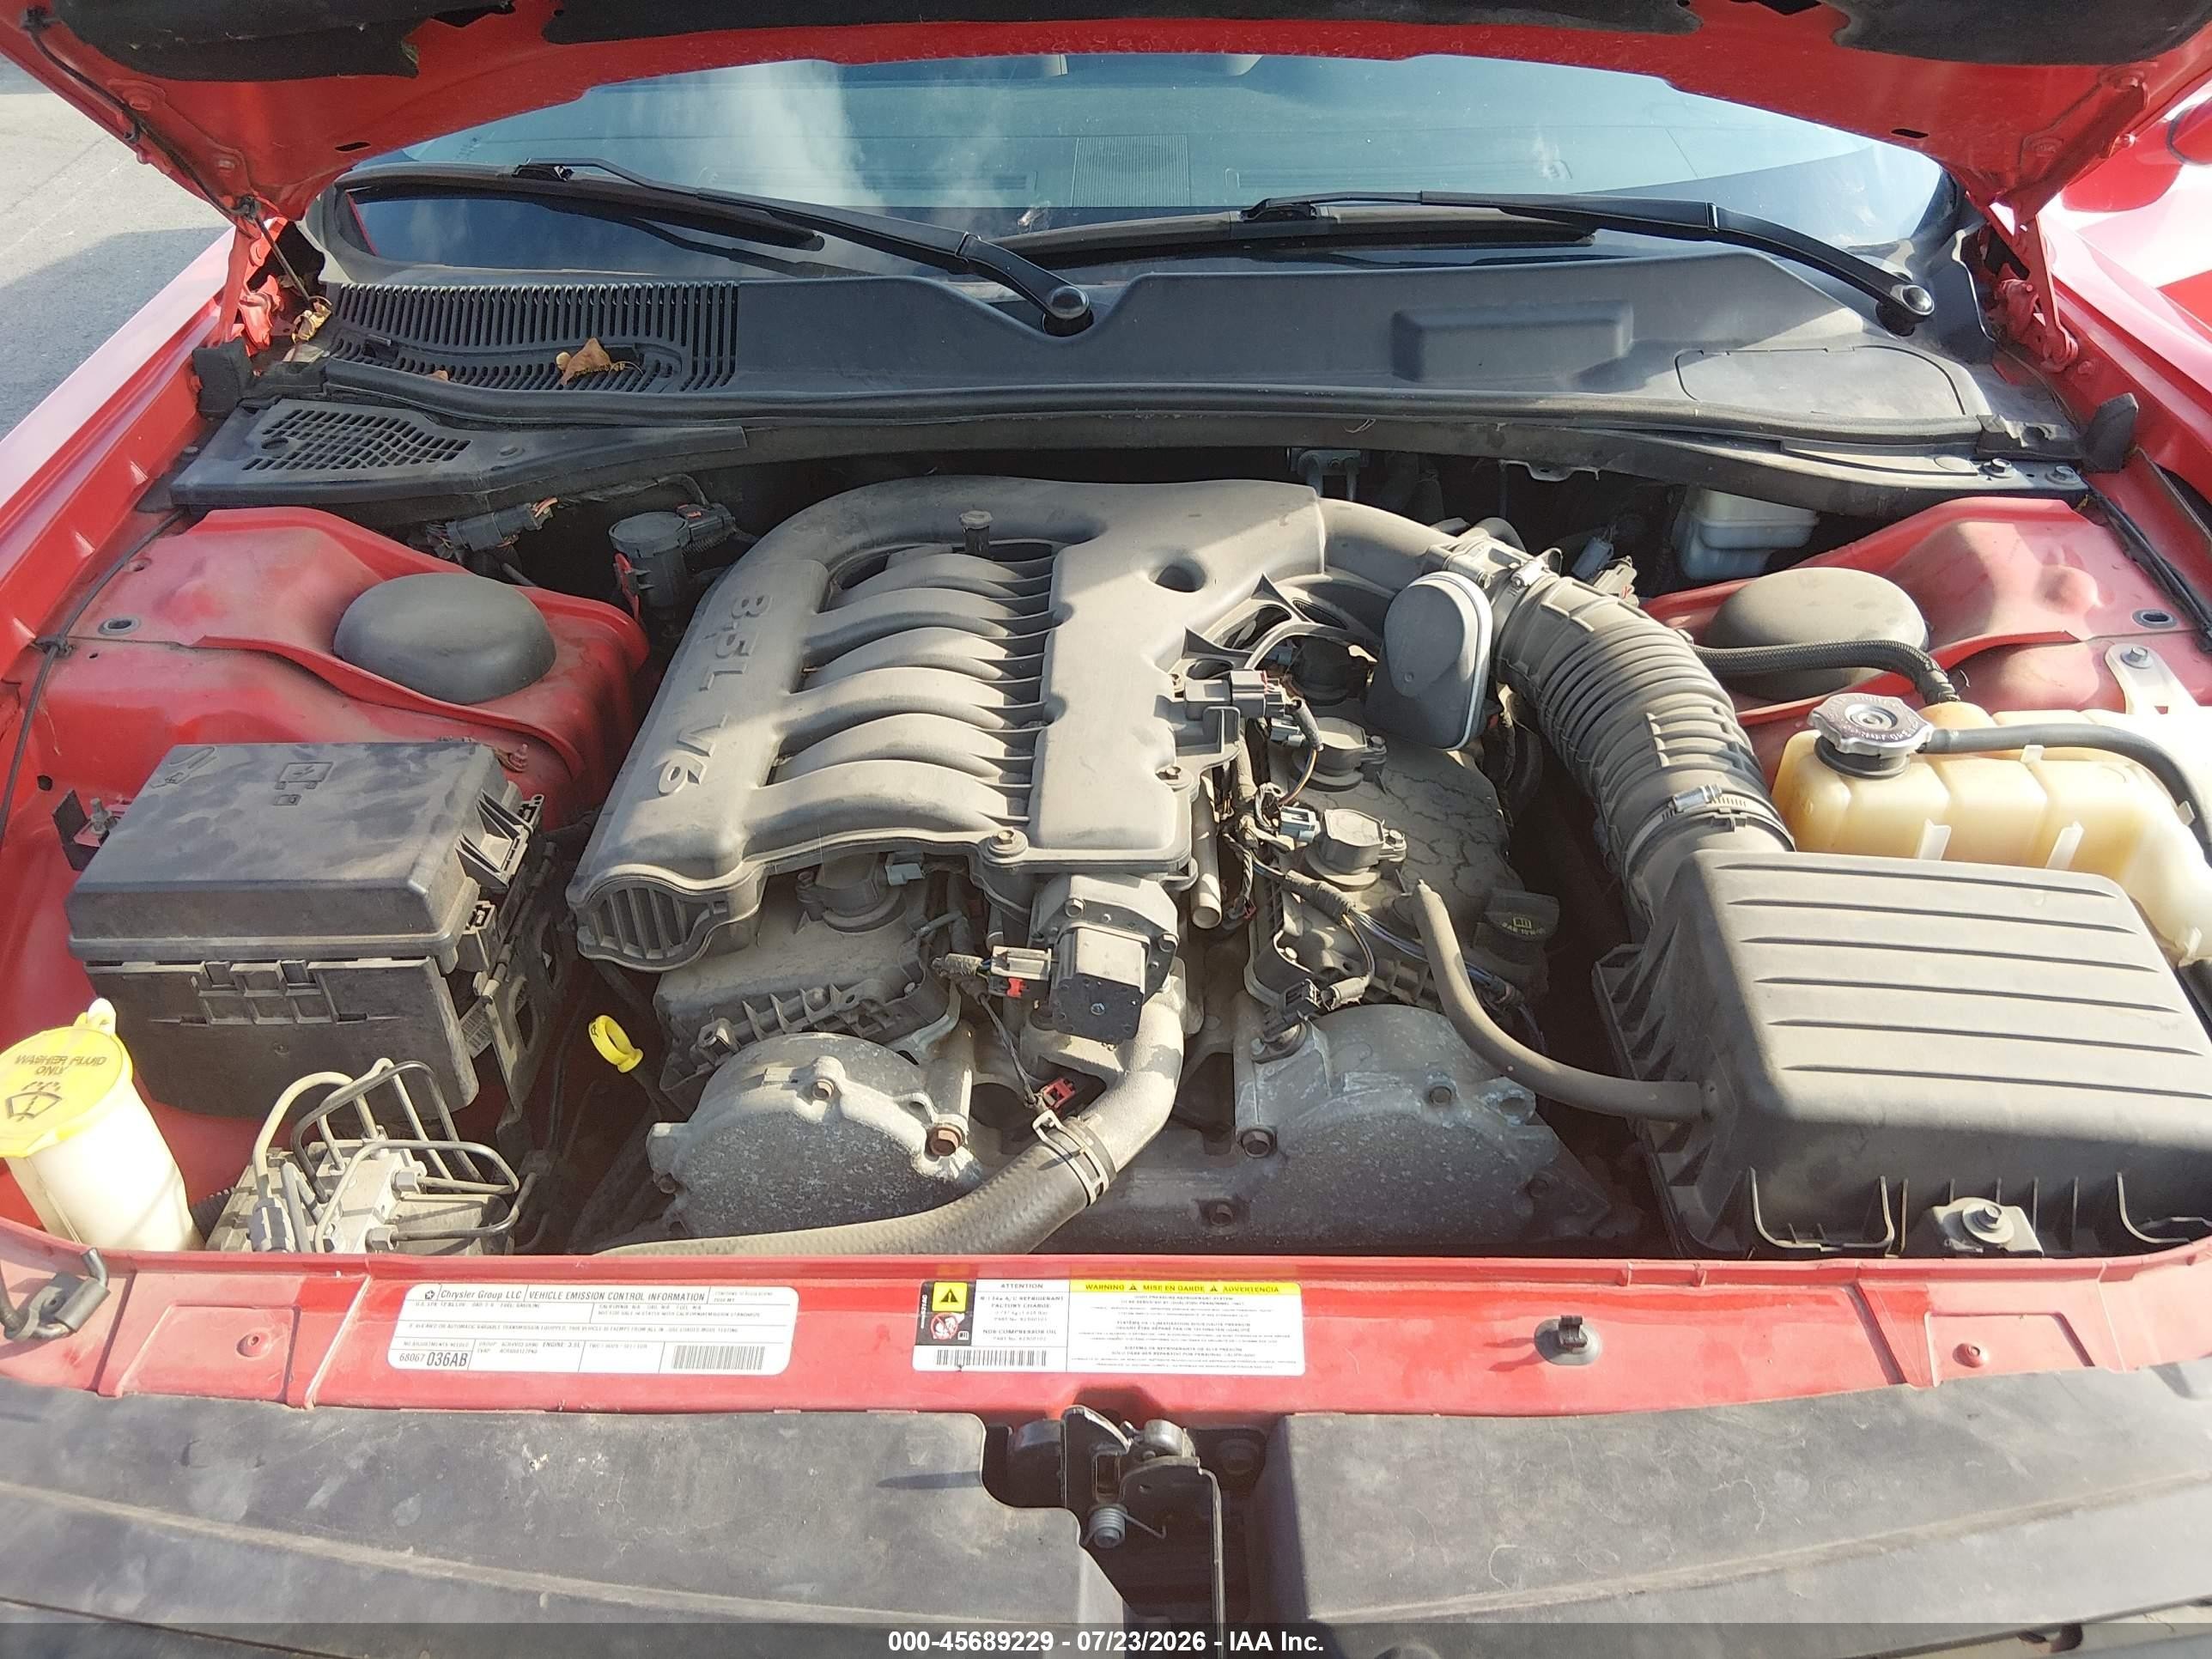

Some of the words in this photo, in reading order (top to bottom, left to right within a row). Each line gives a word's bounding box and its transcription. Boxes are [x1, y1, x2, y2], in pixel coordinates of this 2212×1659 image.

[659, 714, 727, 796] V6
[15, 1054, 67, 1066] WASHER
[70, 1055, 107, 1066] FLUID
[34, 1066, 70, 1075] ONLY
[440, 1291, 476, 1300] Chrysler
[477, 1291, 502, 1300] Group
[506, 1291, 522, 1299] LLC
[529, 1291, 562, 1300] VEHICLE
[565, 1291, 605, 1301] EMISSION
[607, 1292, 645, 1301] CONTROL
[647, 1292, 705, 1302] INFORMATION
[399, 1352, 426, 1363] 68067
[426, 1352, 468, 1367] 036AB
